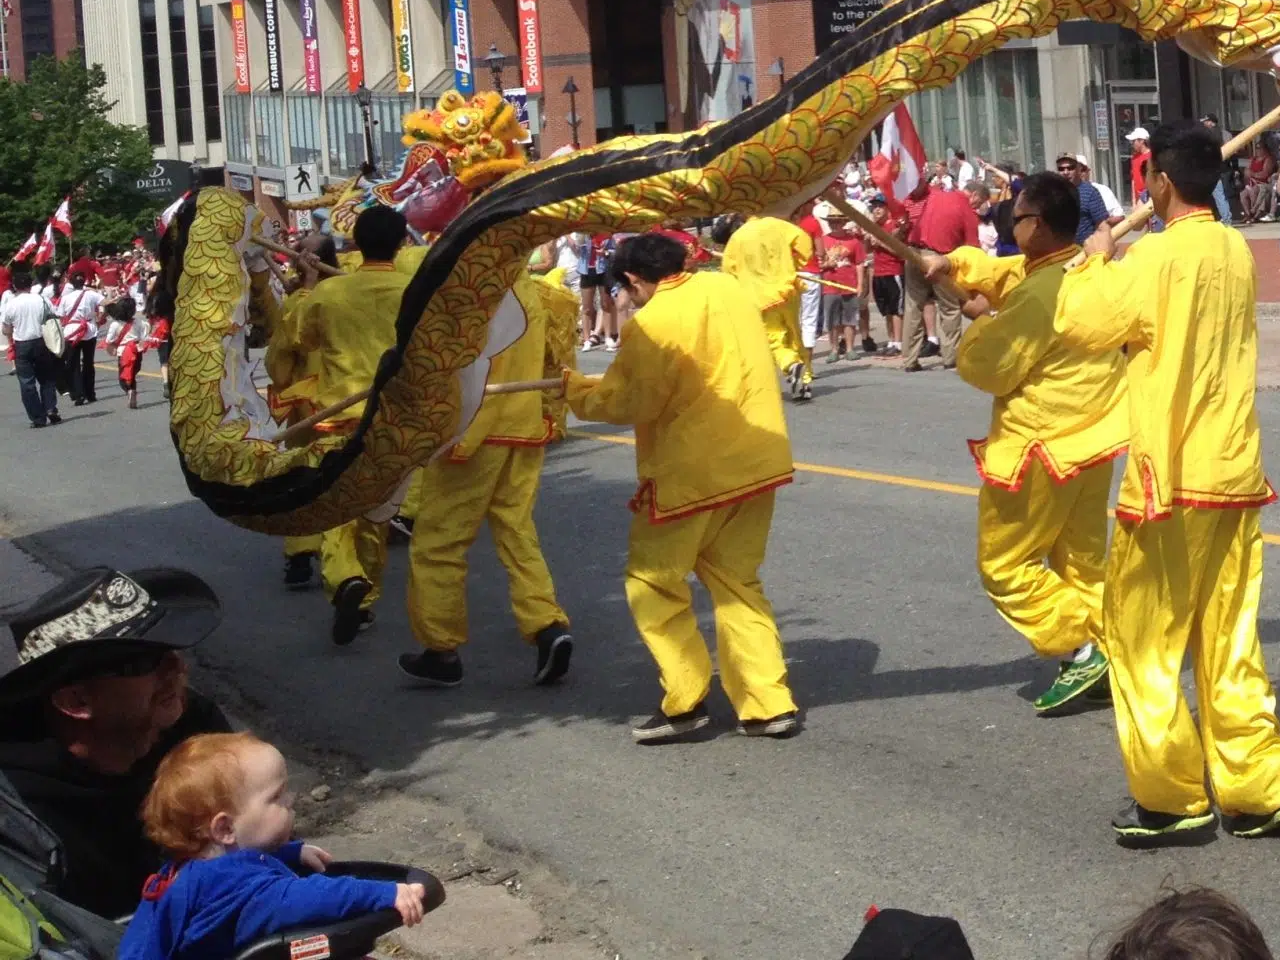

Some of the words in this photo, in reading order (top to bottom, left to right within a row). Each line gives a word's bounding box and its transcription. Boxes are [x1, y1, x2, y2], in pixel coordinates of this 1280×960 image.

[832, 11, 845, 20] to
[846, 10, 865, 19] the
[457, 12, 466, 51] STORE
[830, 23, 856, 33] level
[268, 32, 280, 89] STARBUCKS
[524, 17, 538, 87] Scotiabank
[307, 54, 315, 72] Sushi
[309, 75, 317, 92] Pink
[136, 178, 172, 188] DELTA
